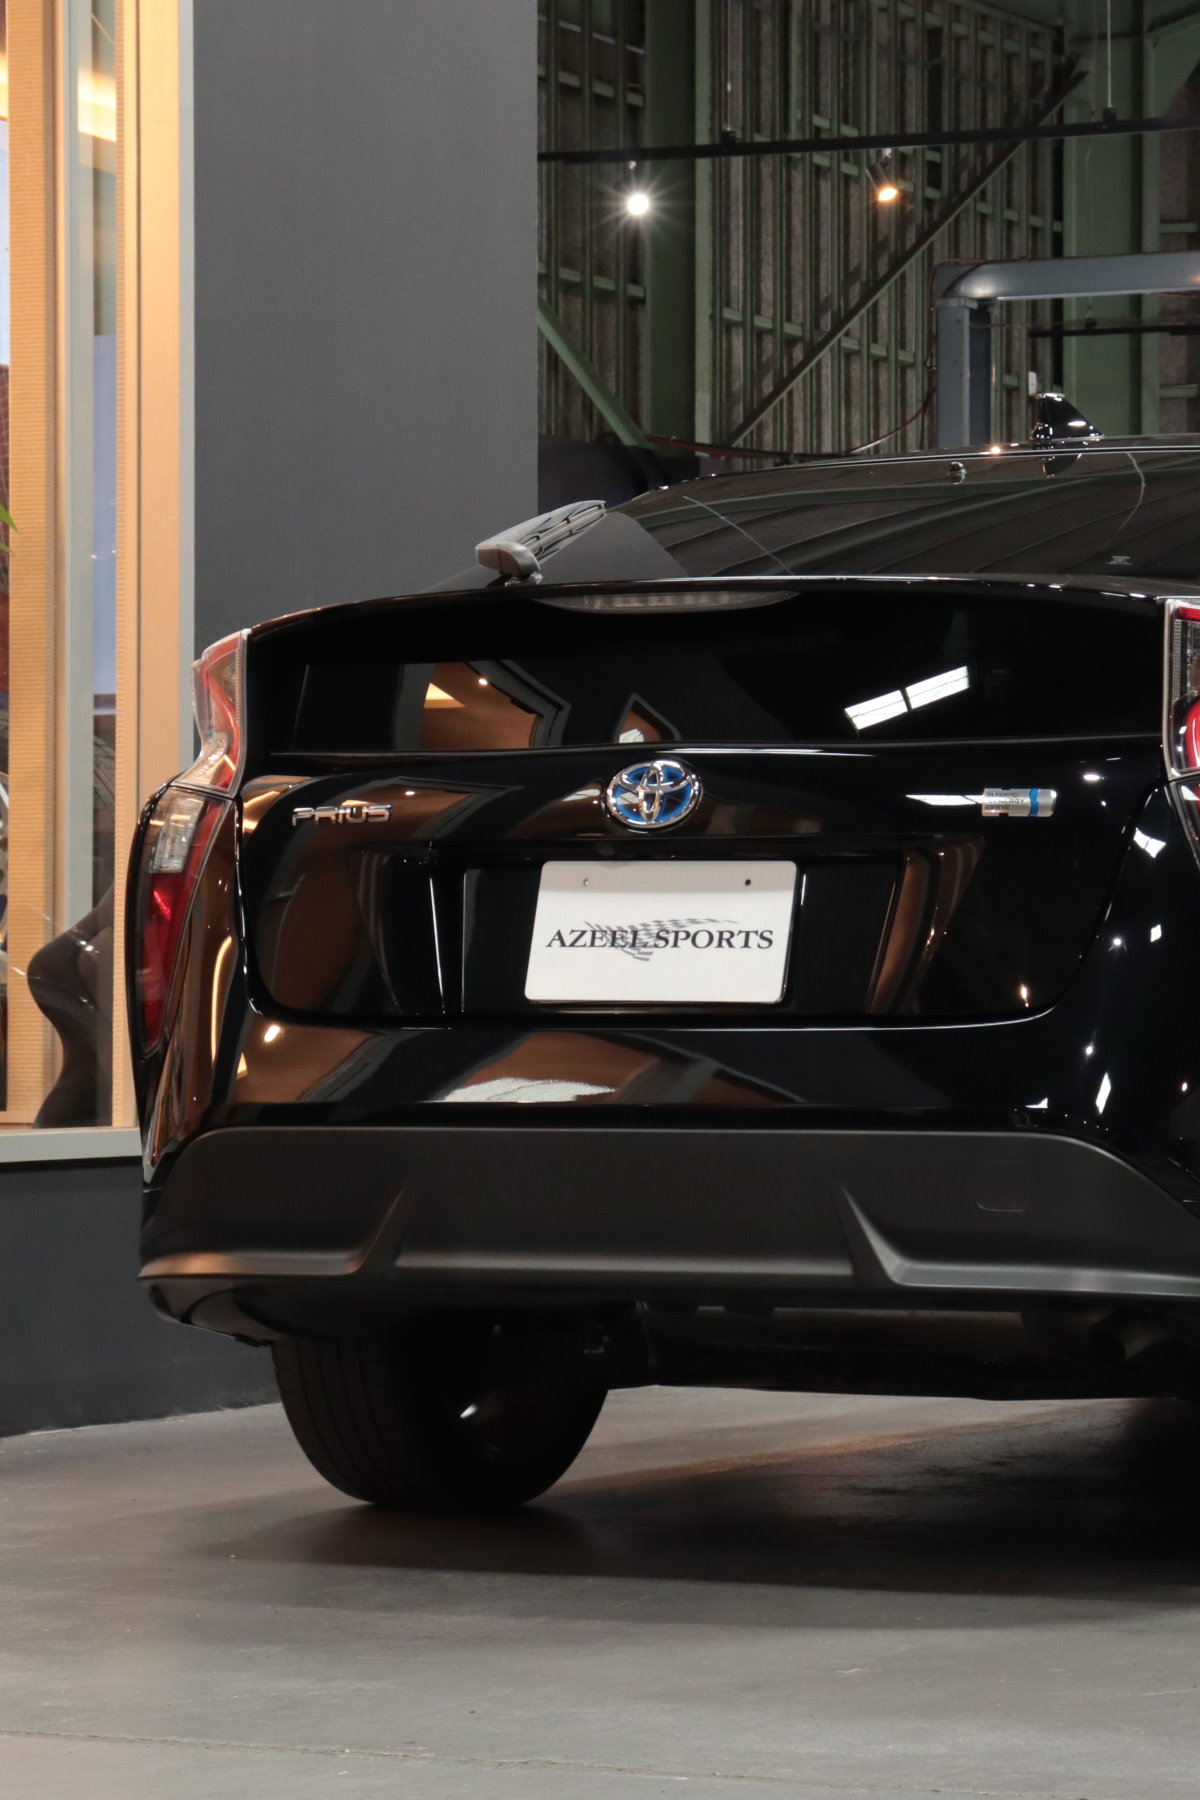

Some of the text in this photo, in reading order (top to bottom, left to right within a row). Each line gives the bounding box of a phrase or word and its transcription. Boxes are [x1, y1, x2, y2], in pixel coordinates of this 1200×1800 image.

[291, 804, 392, 827] PRIUS
[546, 929, 774, 949] AZEEL SPORTS
